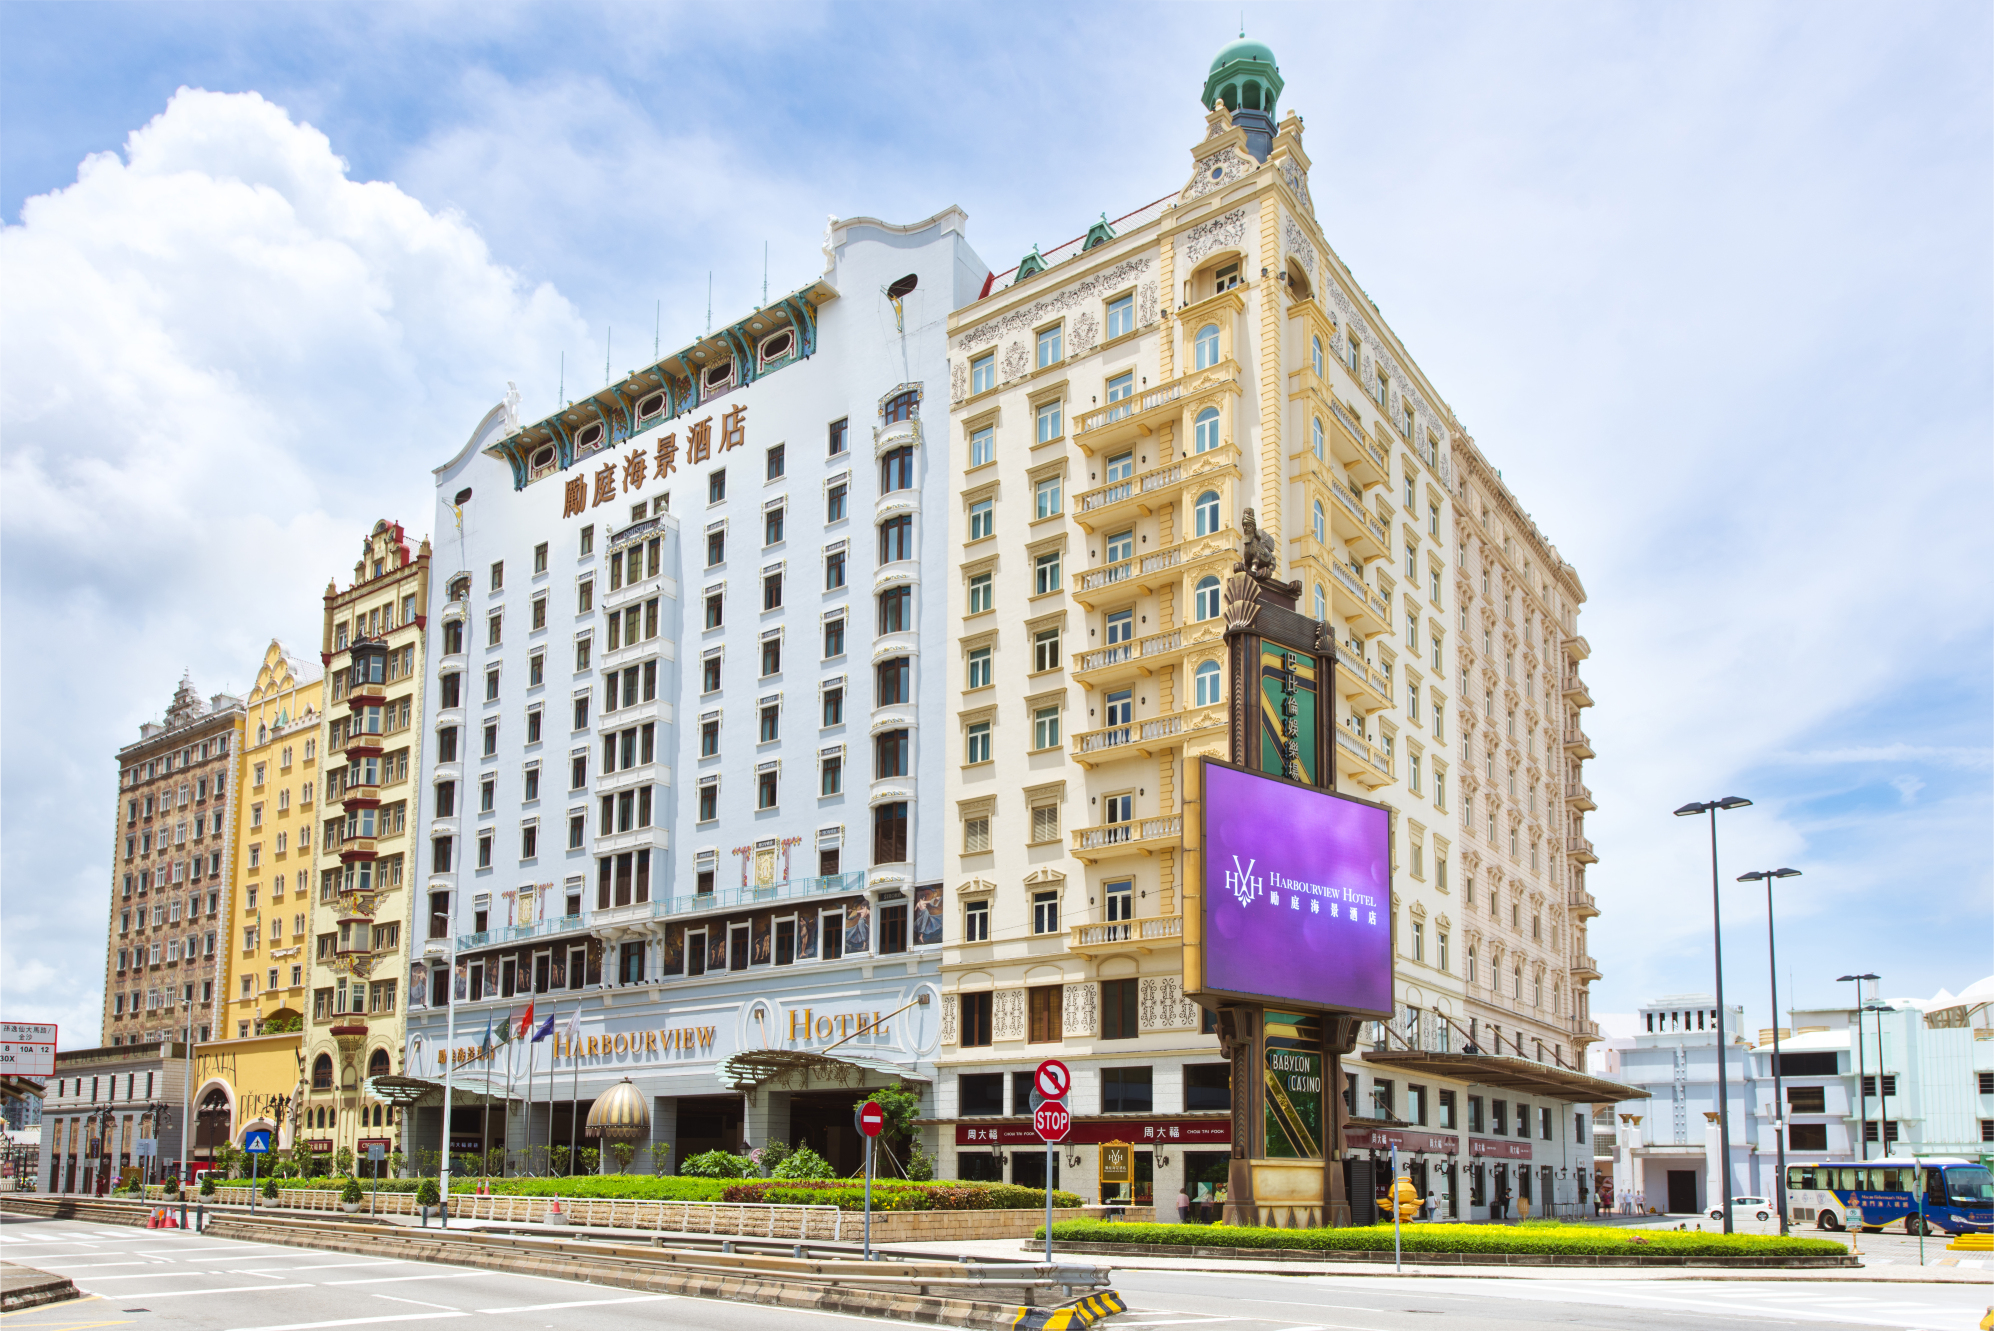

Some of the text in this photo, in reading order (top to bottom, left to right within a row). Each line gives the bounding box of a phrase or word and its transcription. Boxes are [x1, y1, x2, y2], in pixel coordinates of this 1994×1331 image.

[563, 404, 747, 519] 勵庭海景酒店
[1270, 872, 1376, 907] HARBOURVIEW HOTEL
[1270, 891, 1376, 925] 勵庭海景酒店
[787, 1008, 890, 1040] HOTEL
[554, 1026, 716, 1058] HARBOURVIEW
[196, 1052, 237, 1092] PRAHA
[1272, 1054, 1310, 1072] BABYLON
[1290, 1075, 1321, 1092] CASINO
[967, 1128, 998, 1140] 周大福
[1037, 1112, 1067, 1130] STOP
[1144, 1127, 1179, 1138] 周大福
